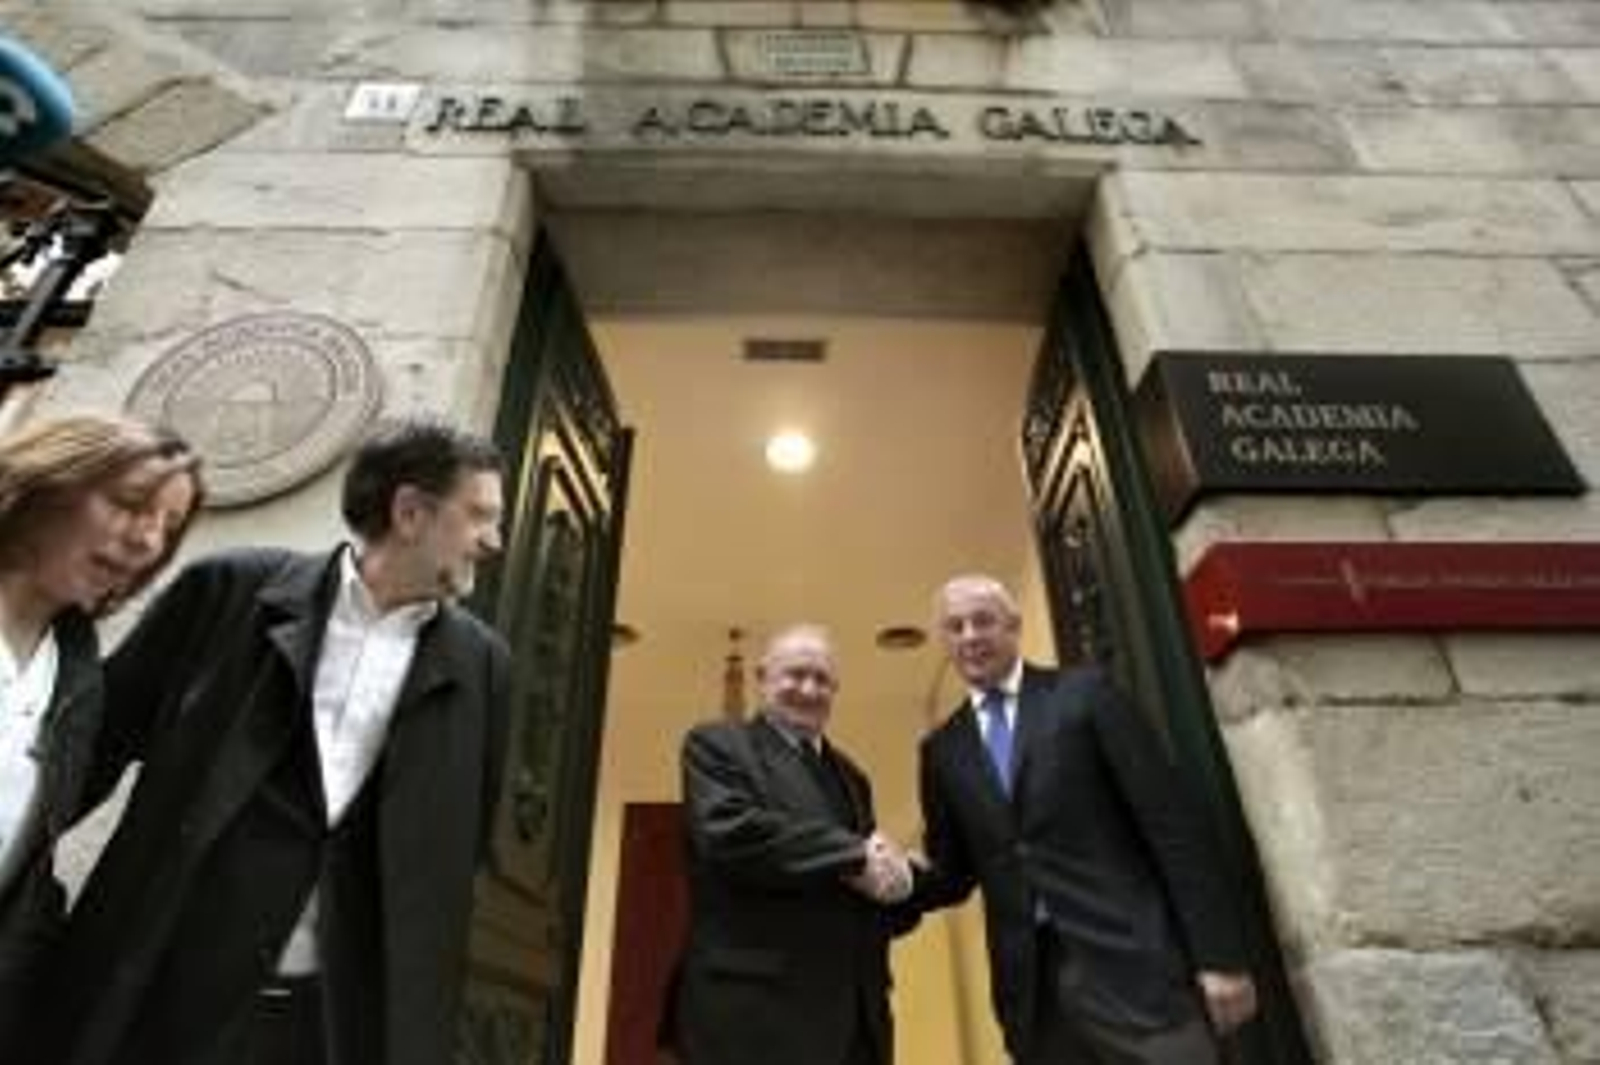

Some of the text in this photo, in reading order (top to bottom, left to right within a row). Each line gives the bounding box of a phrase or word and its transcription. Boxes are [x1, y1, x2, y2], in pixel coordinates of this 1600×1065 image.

[425, 96, 1202, 146] REAL ACADEMIA GALEGA
[1207, 371, 1302, 396] REAL
[1220, 403, 1418, 430] ACADEMIA
[1231, 436, 1386, 466] GALEGA
